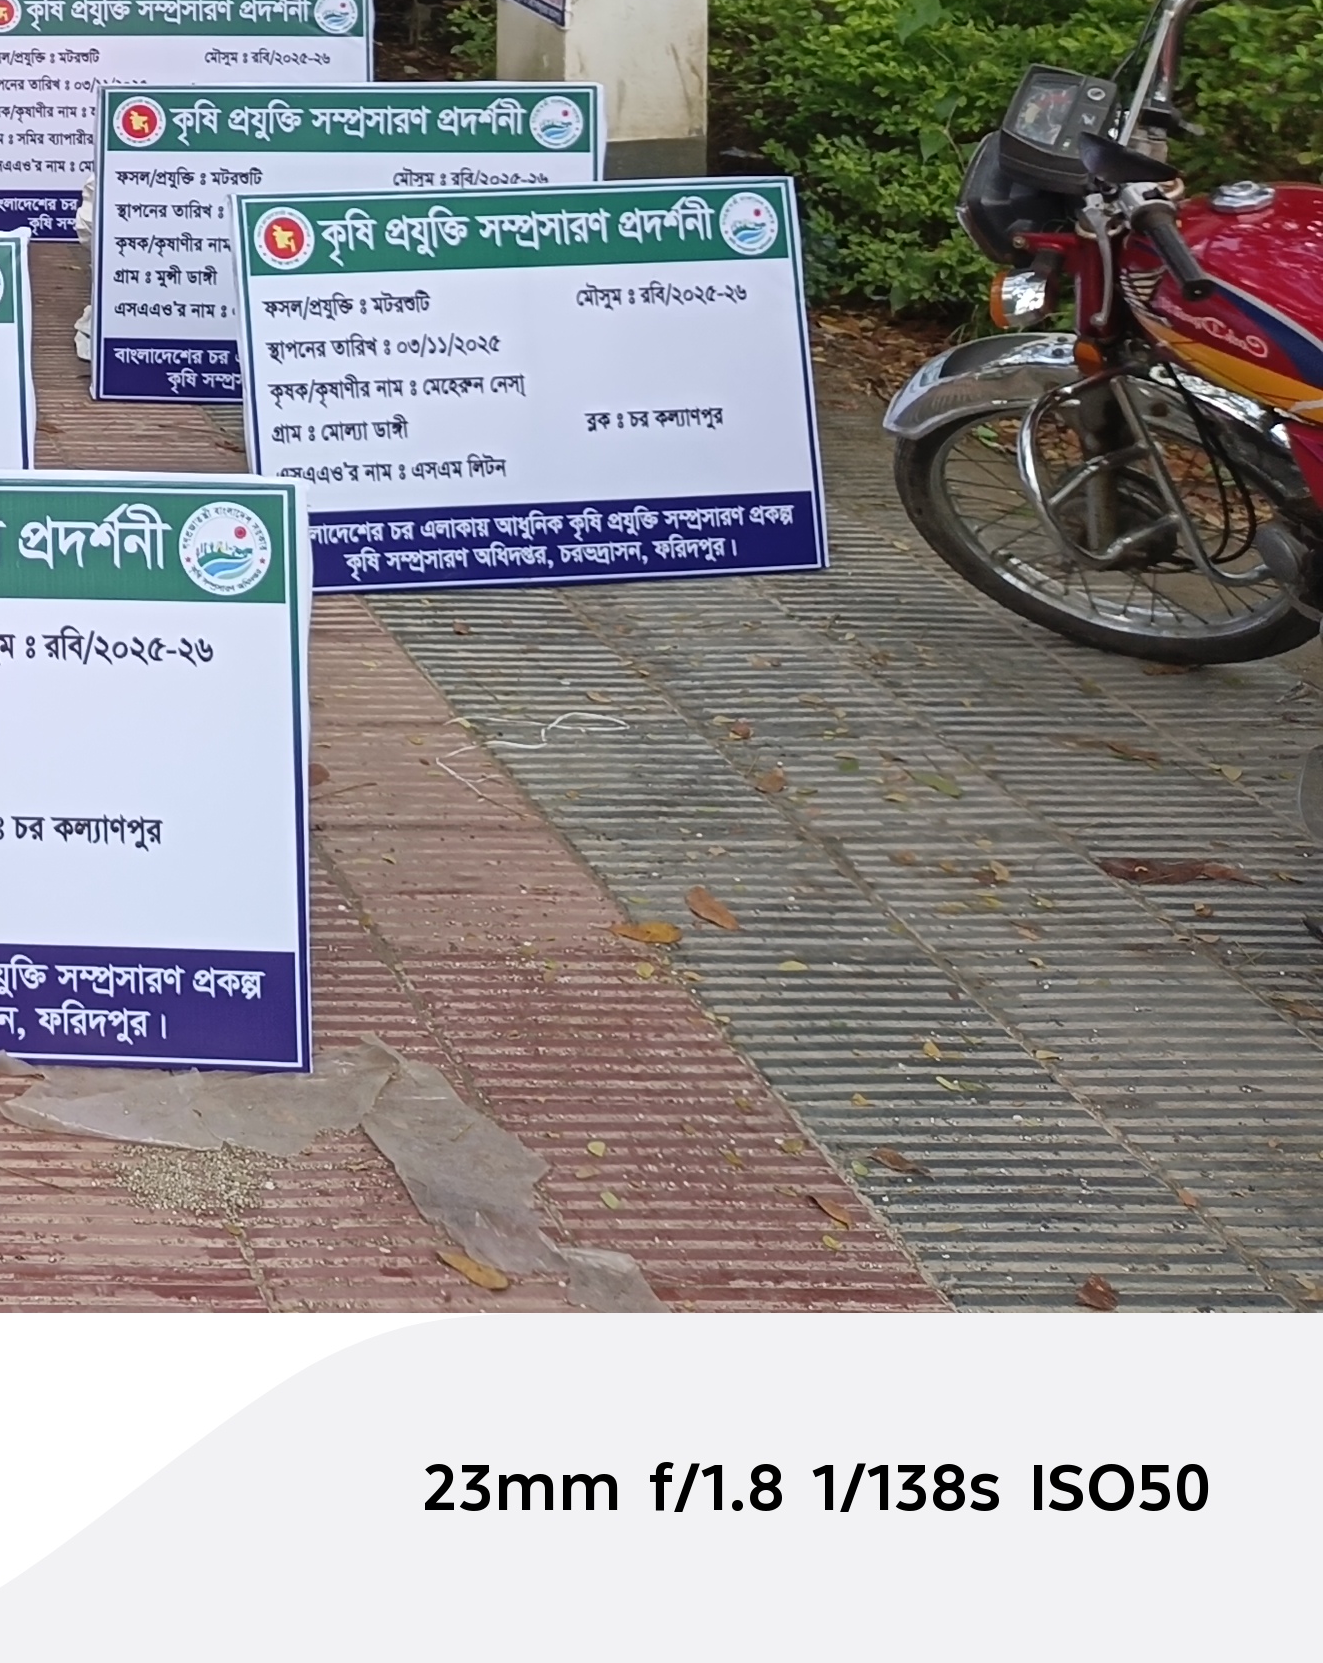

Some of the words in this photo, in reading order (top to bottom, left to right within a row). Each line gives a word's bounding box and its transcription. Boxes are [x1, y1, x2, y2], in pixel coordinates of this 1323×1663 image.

[169, 99, 222, 146] কৃষি
[228, 99, 304, 141] প্রযুক্তি
[309, 106, 431, 138] সম্প্রসারণ
[437, 98, 527, 136] প্রদর্শনী
[317, 208, 377, 265] কৃষি
[385, 206, 470, 257] প্রযুক্তি
[475, 208, 611, 250] সম্প্রসারণ
[618, 196, 715, 243] প্রদর্শনী
[262, 292, 353, 321] ফসল/প্রযুক্তি
[272, 424, 302, 443] গ্রাম
[321, 422, 368, 441] মোল্যা
[372, 414, 408, 439] ডাঙ্গী
[19, 504, 172, 569] প্রদর্শনী
[11, 816, 45, 841] চর
[51, 815, 163, 851] কল্যাণপুর
[35, 1001, 151, 1045] ফরিদপুর
